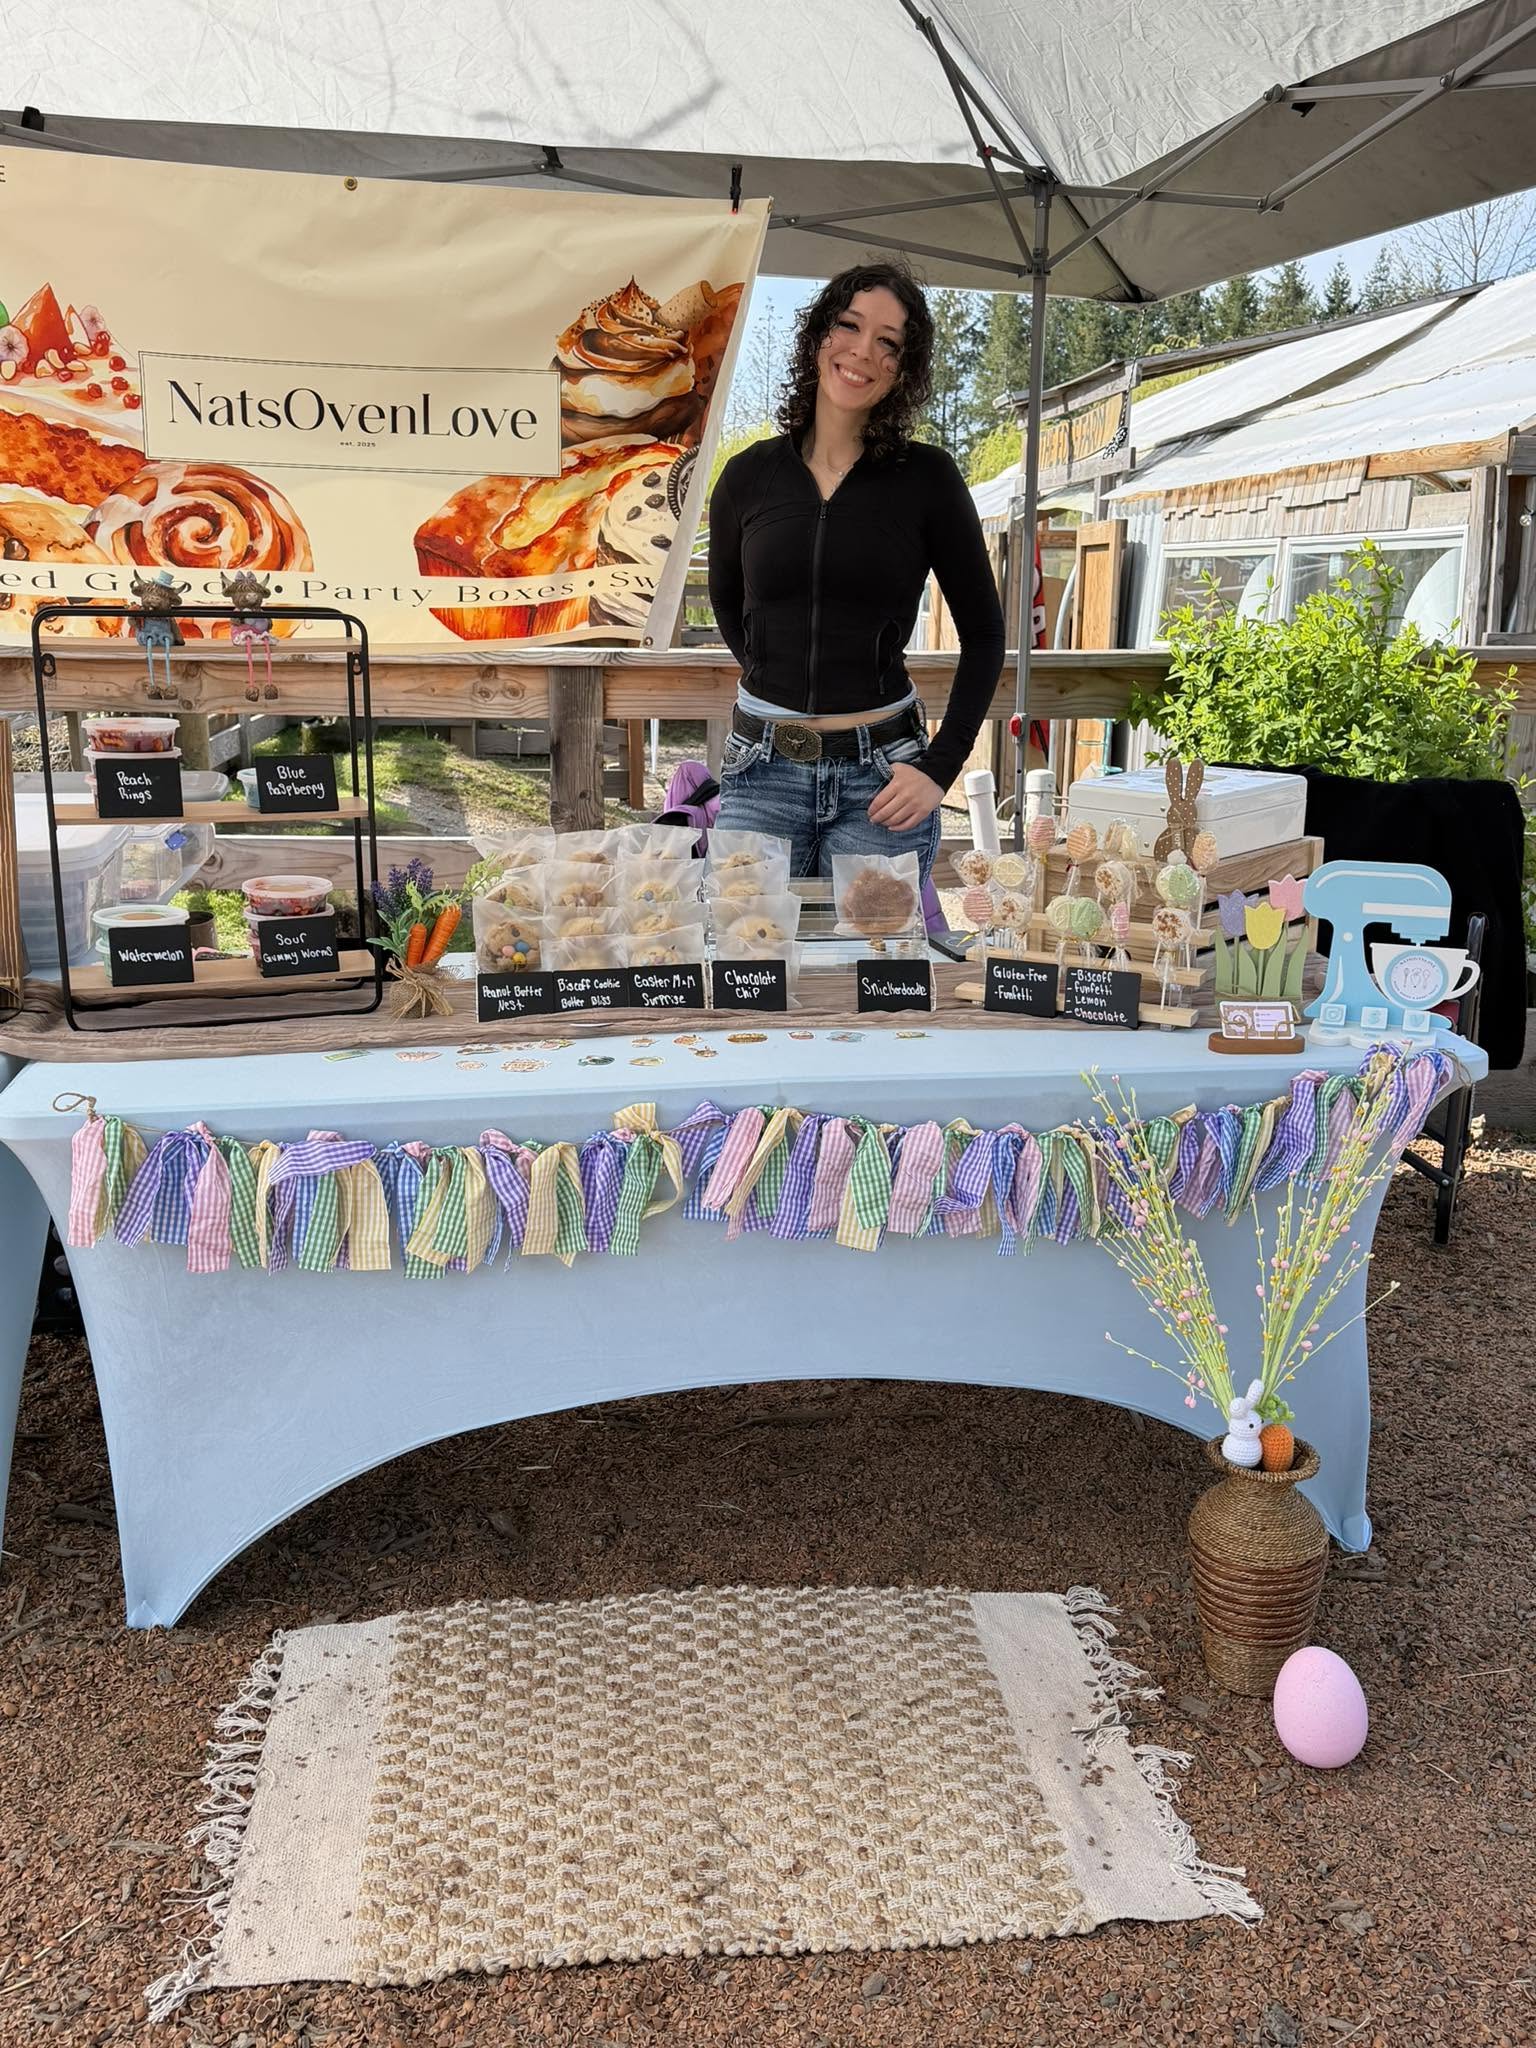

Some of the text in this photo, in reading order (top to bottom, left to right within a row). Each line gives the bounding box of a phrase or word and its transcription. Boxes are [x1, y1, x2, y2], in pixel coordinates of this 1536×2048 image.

[167, 379, 538, 440] NatsOvenLove
[302, 579, 432, 608] Party
[457, 581, 575, 604] Boxes
[116, 770, 153, 786] Peach
[276, 765, 307, 780] Blue
[118, 786, 153, 805] Rings
[265, 780, 325, 800] Raspberry
[275, 932, 307, 946] Sour
[117, 948, 185, 963] Watermelon
[262, 945, 334, 966] Gummy Worms
[633, 973, 671, 989] Easter
[724, 968, 777, 986] Chocolate
[992, 965, 1048, 982] Gluten-Free
[482, 984, 512, 999] Peanut
[556, 977, 592, 993] Biscoff
[861, 976, 928, 997] Snickerdoodle
[497, 998, 526, 1014] Nest
[641, 991, 687, 1007] Surprise
